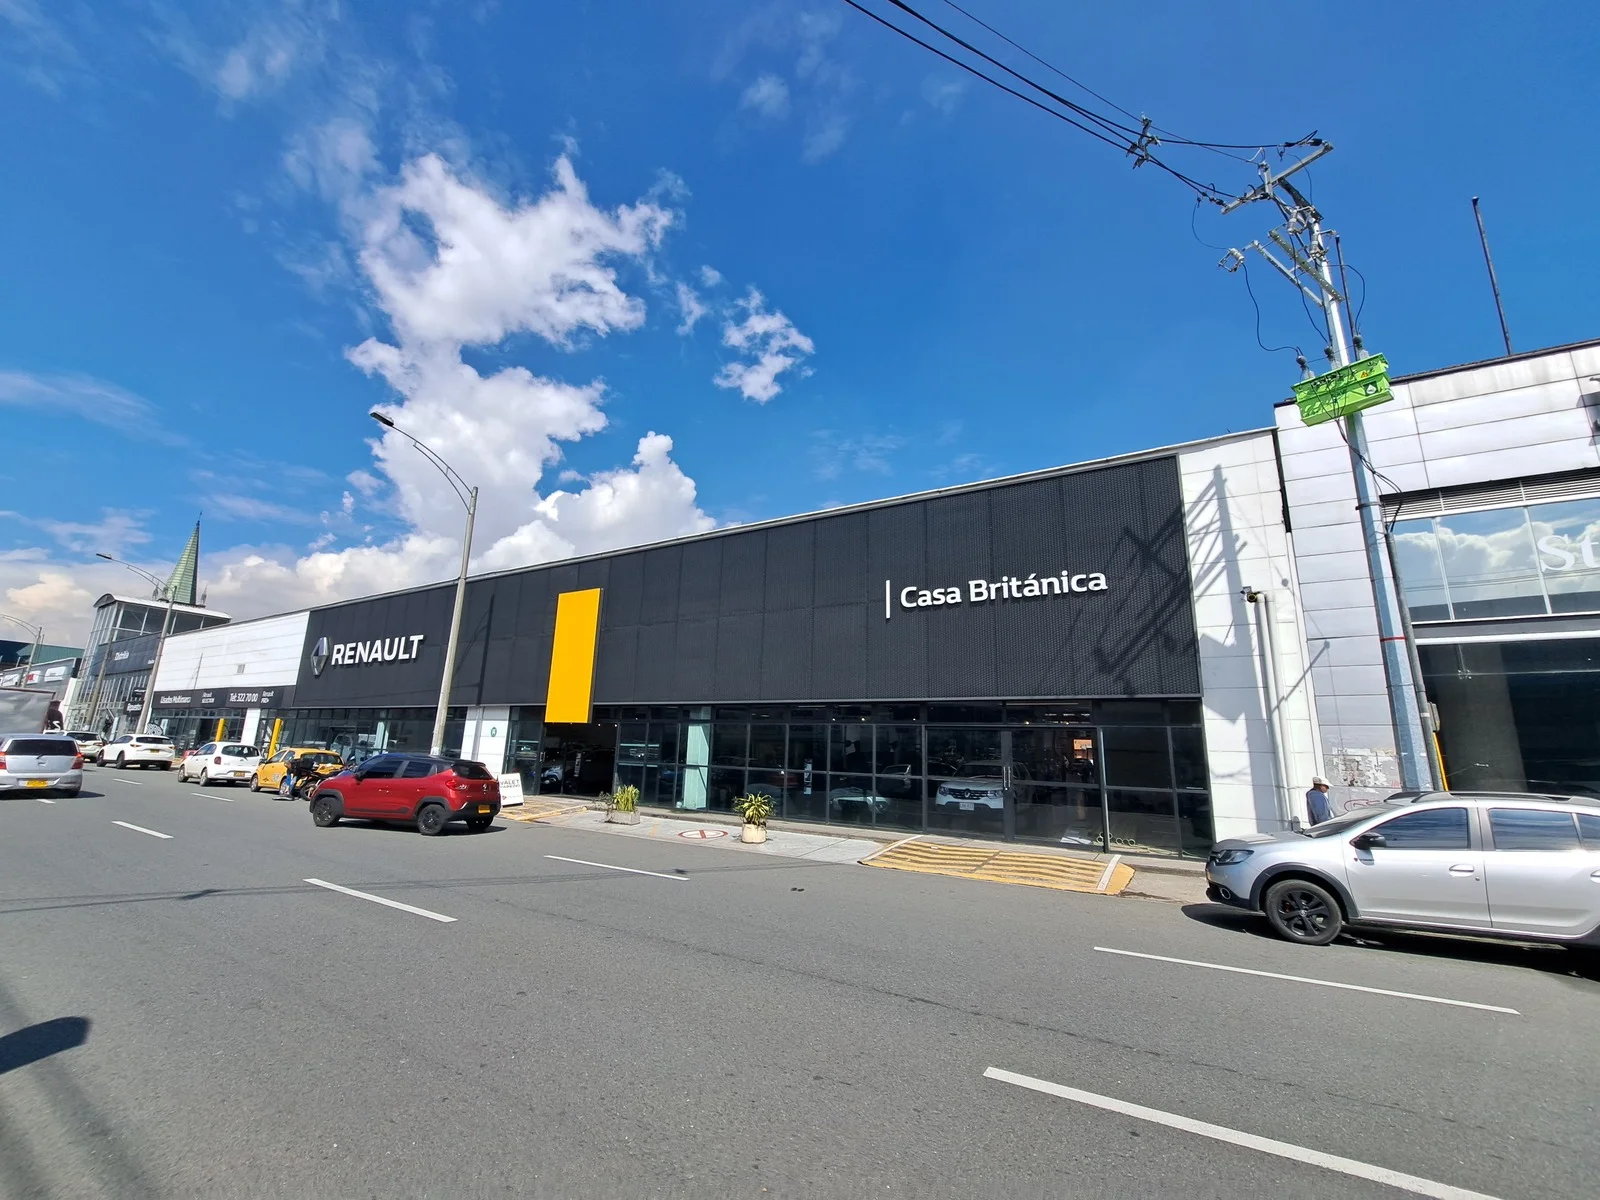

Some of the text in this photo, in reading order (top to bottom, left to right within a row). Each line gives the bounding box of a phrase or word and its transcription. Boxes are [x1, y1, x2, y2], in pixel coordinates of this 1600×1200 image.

[900, 570, 1108, 608] Casa Británica
[331, 634, 424, 665] RENAULT
